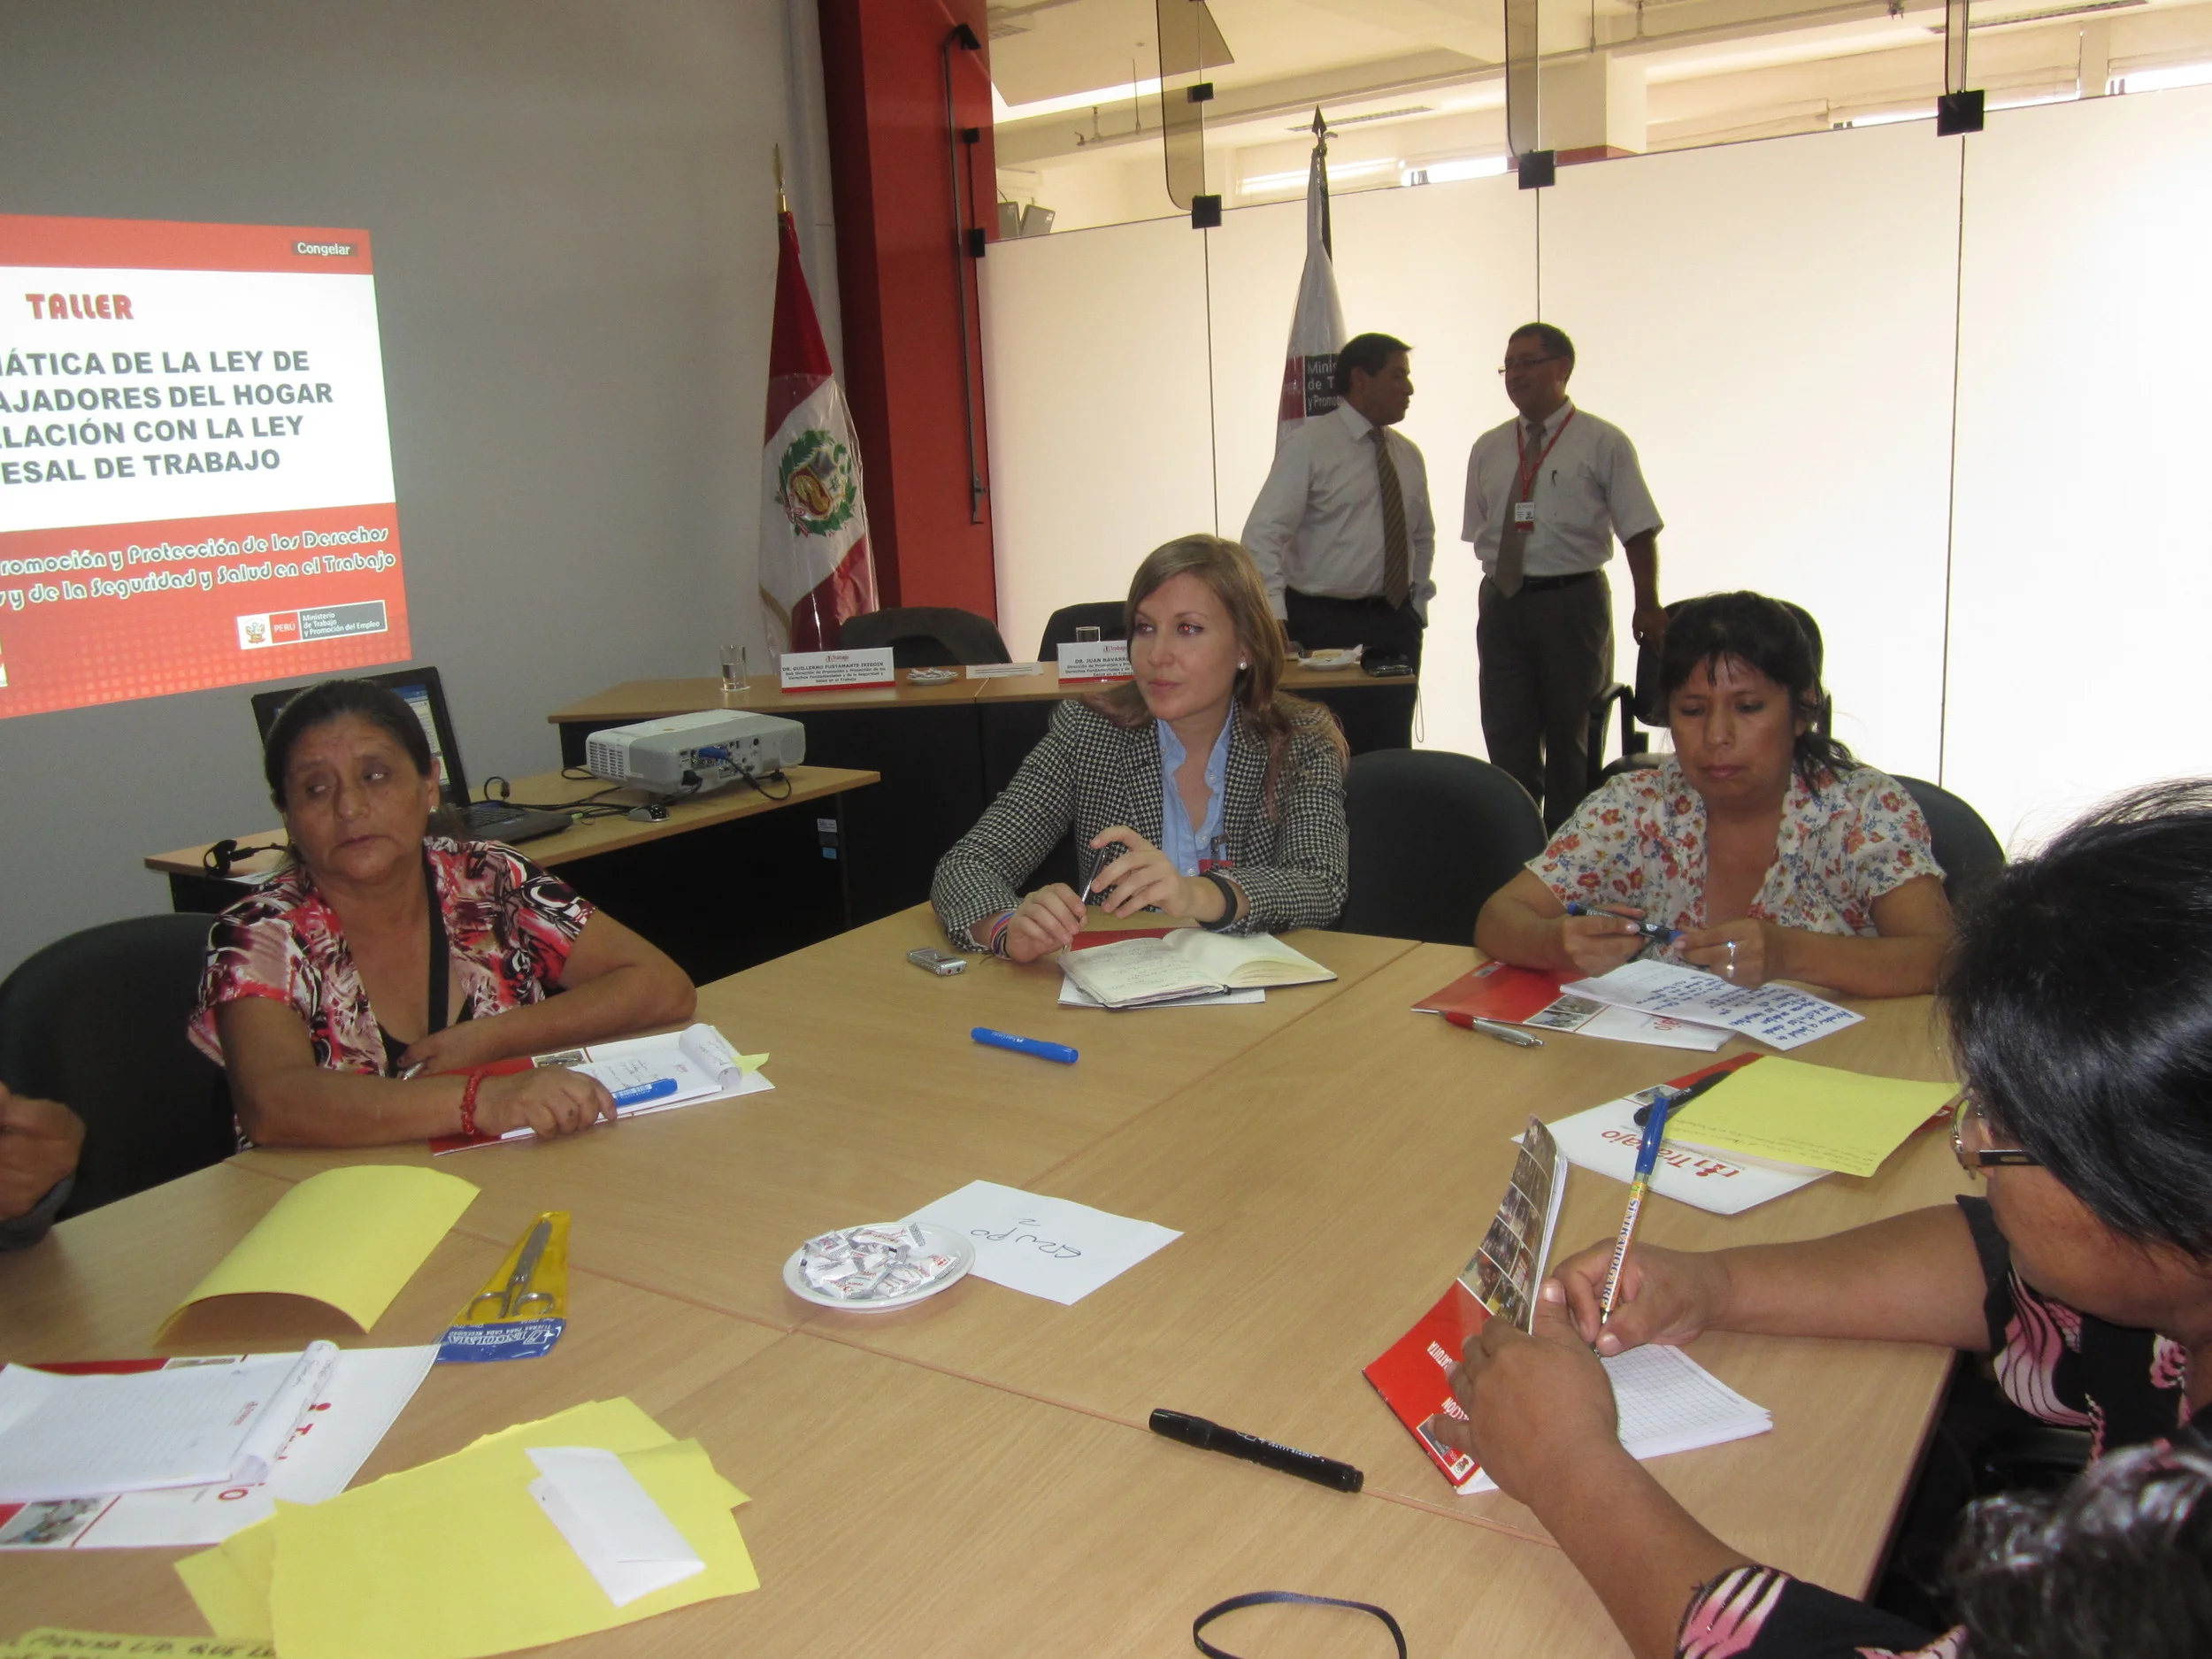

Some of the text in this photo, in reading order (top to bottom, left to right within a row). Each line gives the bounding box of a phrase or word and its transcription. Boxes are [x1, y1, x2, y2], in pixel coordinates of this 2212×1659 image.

[297, 242, 350, 257] Congelar
[26, 293, 134, 319] TALLER
[0, 348, 311, 376] ÁTICA DE LA LEY DE
[169, 385, 226, 408] DEL
[234, 382, 334, 405] HOGAR
[1308, 379, 1322, 390] de
[0, 415, 304, 449] LACIÓN CON LA LEY
[1, 449, 280, 484] ESAL DE TRABAJO
[109, 551, 124, 572] y
[127, 538, 240, 565] Protección
[242, 535, 268, 554] de
[272, 534, 299, 551] los
[303, 526, 388, 549] Derechos
[9, 589, 25, 611] y
[28, 583, 59, 603] de
[62, 580, 88, 601] la
[90, 569, 196, 600] Seguridad
[199, 571, 213, 591] y
[217, 561, 272, 585] Salud
[274, 564, 299, 578] en
[302, 557, 321, 574] el
[323, 549, 396, 572] Trabajo
[273, 621, 296, 633] PERÚ
[303, 612, 335, 621] Ministerio
[310, 625, 344, 636] Promoción
[345, 622, 356, 631] del
[357, 621, 380, 630] Empleo
[313, 619, 337, 628] Trabajo
[1601, 1130, 1692, 1168] Traajo
[1427, 1340, 1453, 1371] RATUITA
